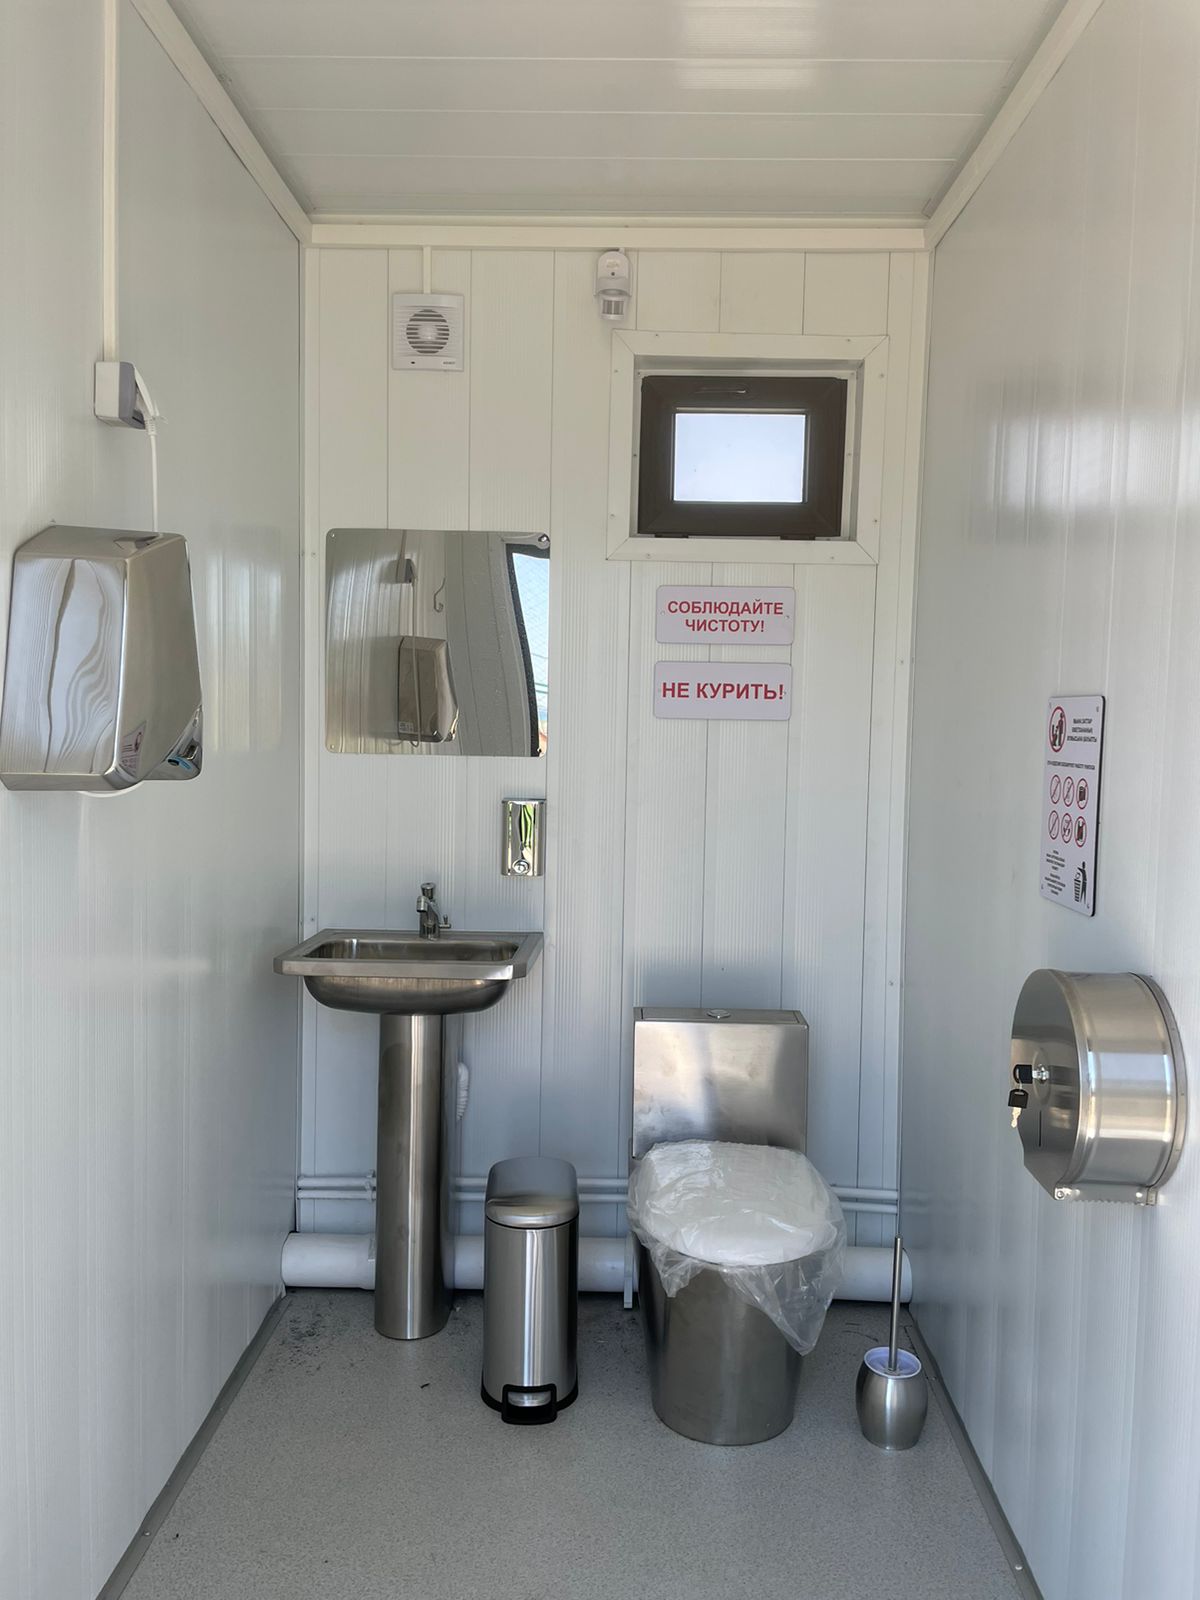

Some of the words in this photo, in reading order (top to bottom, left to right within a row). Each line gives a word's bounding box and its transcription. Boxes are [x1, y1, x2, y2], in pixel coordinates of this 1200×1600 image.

[667, 598, 784, 617] СОБЛЮДАЙТЕ
[685, 618, 765, 633] ЧИСТОТУ!
[662, 682, 690, 699] НЕ
[696, 683, 784, 700] КУРИТЬ!
